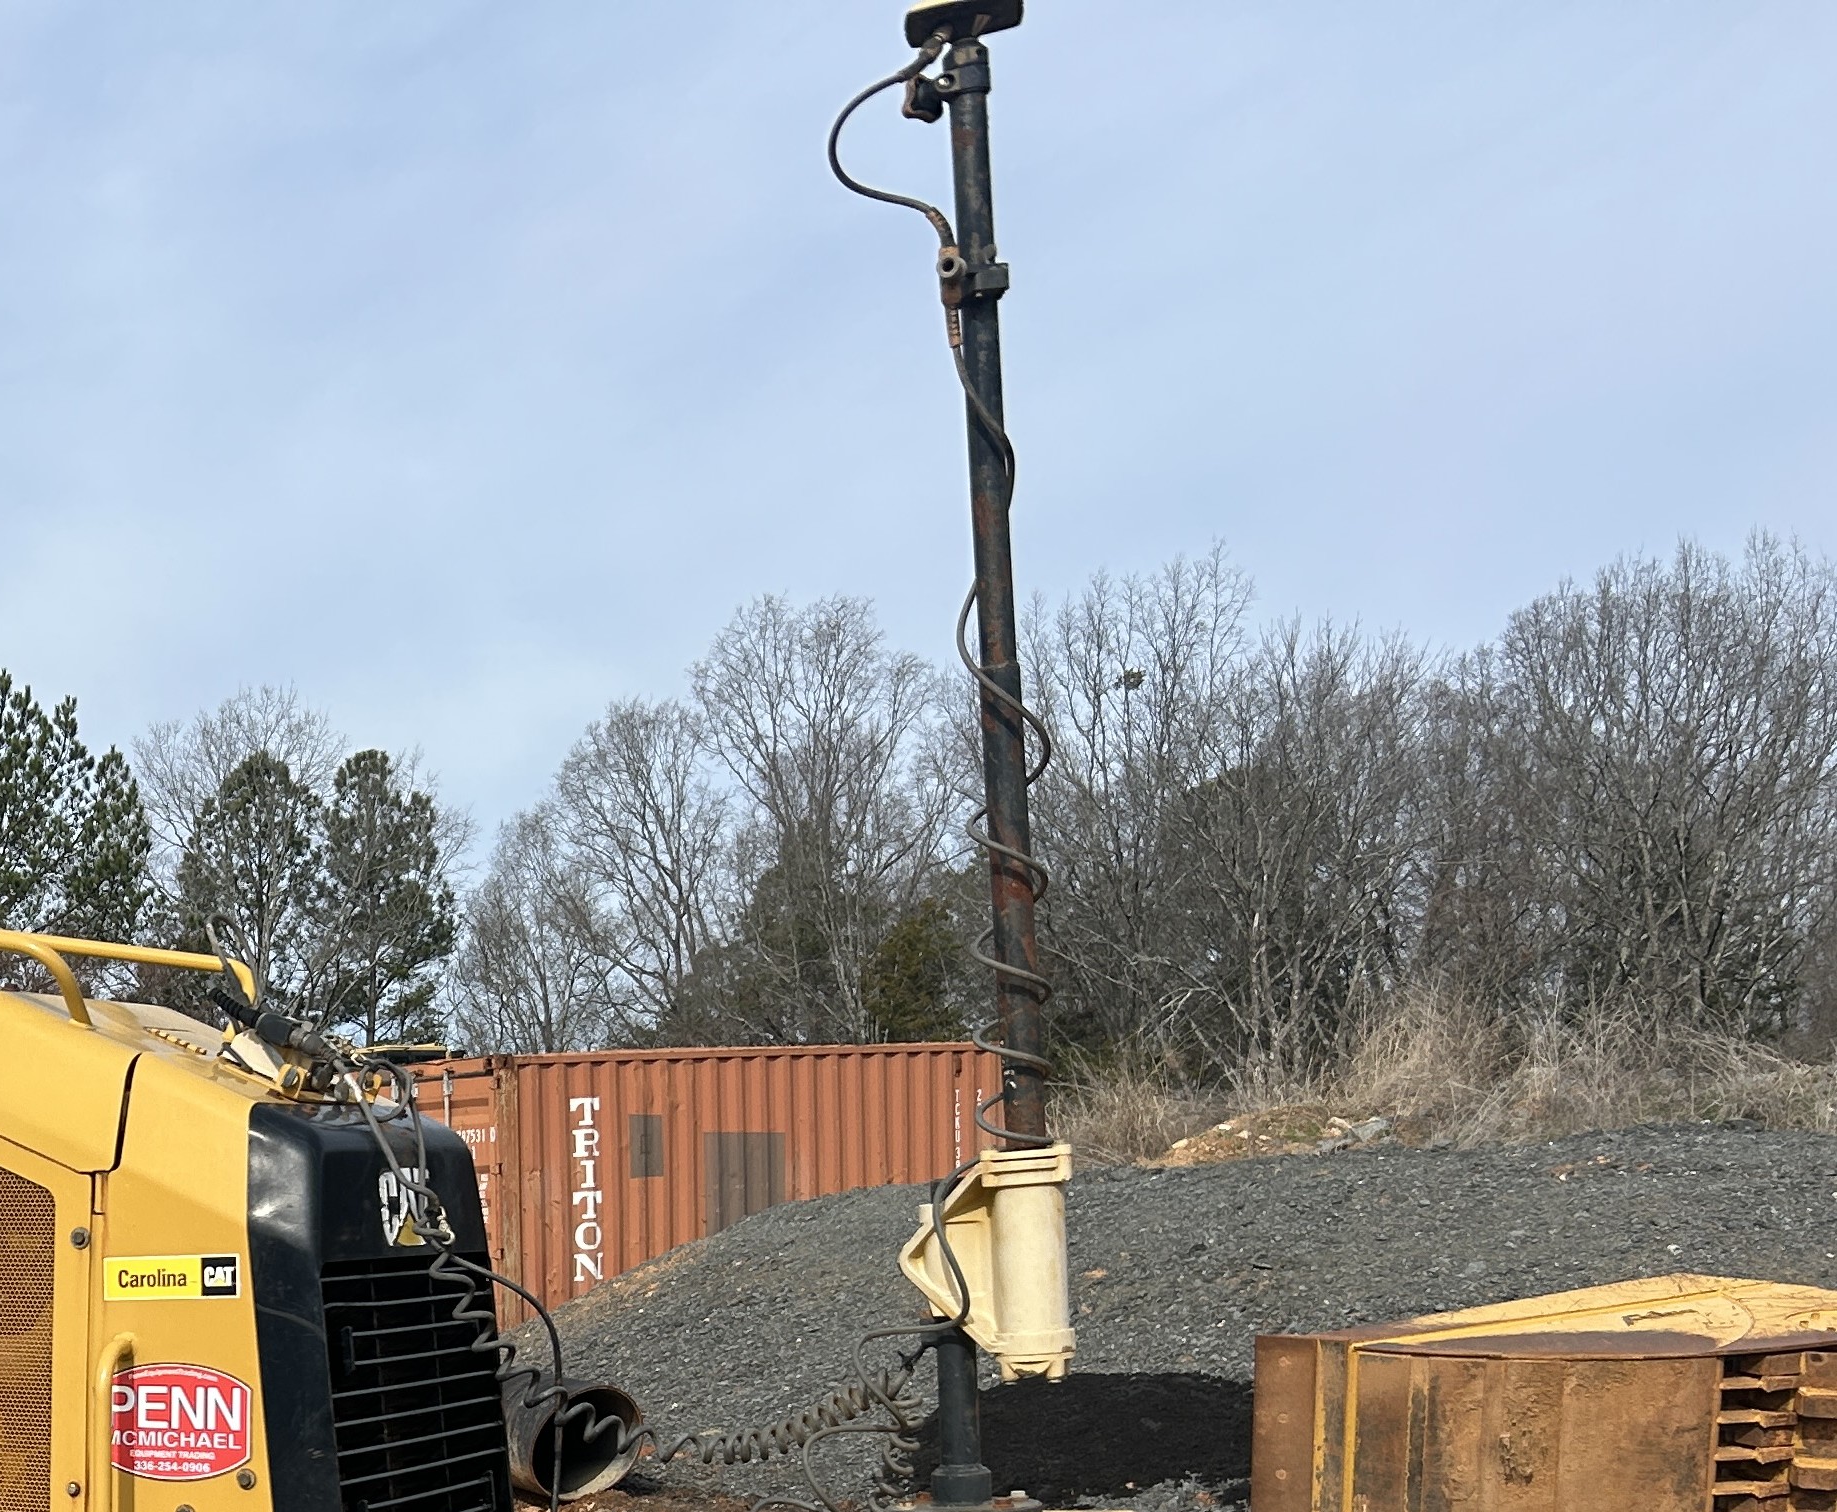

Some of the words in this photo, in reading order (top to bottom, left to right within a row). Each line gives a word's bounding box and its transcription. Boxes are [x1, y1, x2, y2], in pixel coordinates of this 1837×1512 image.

[569, 1097, 604, 1282] TRITON
[118, 1268, 187, 1288] Carolina
[203, 1265, 236, 1288] CAT
[111, 1385, 242, 1431] PENN
